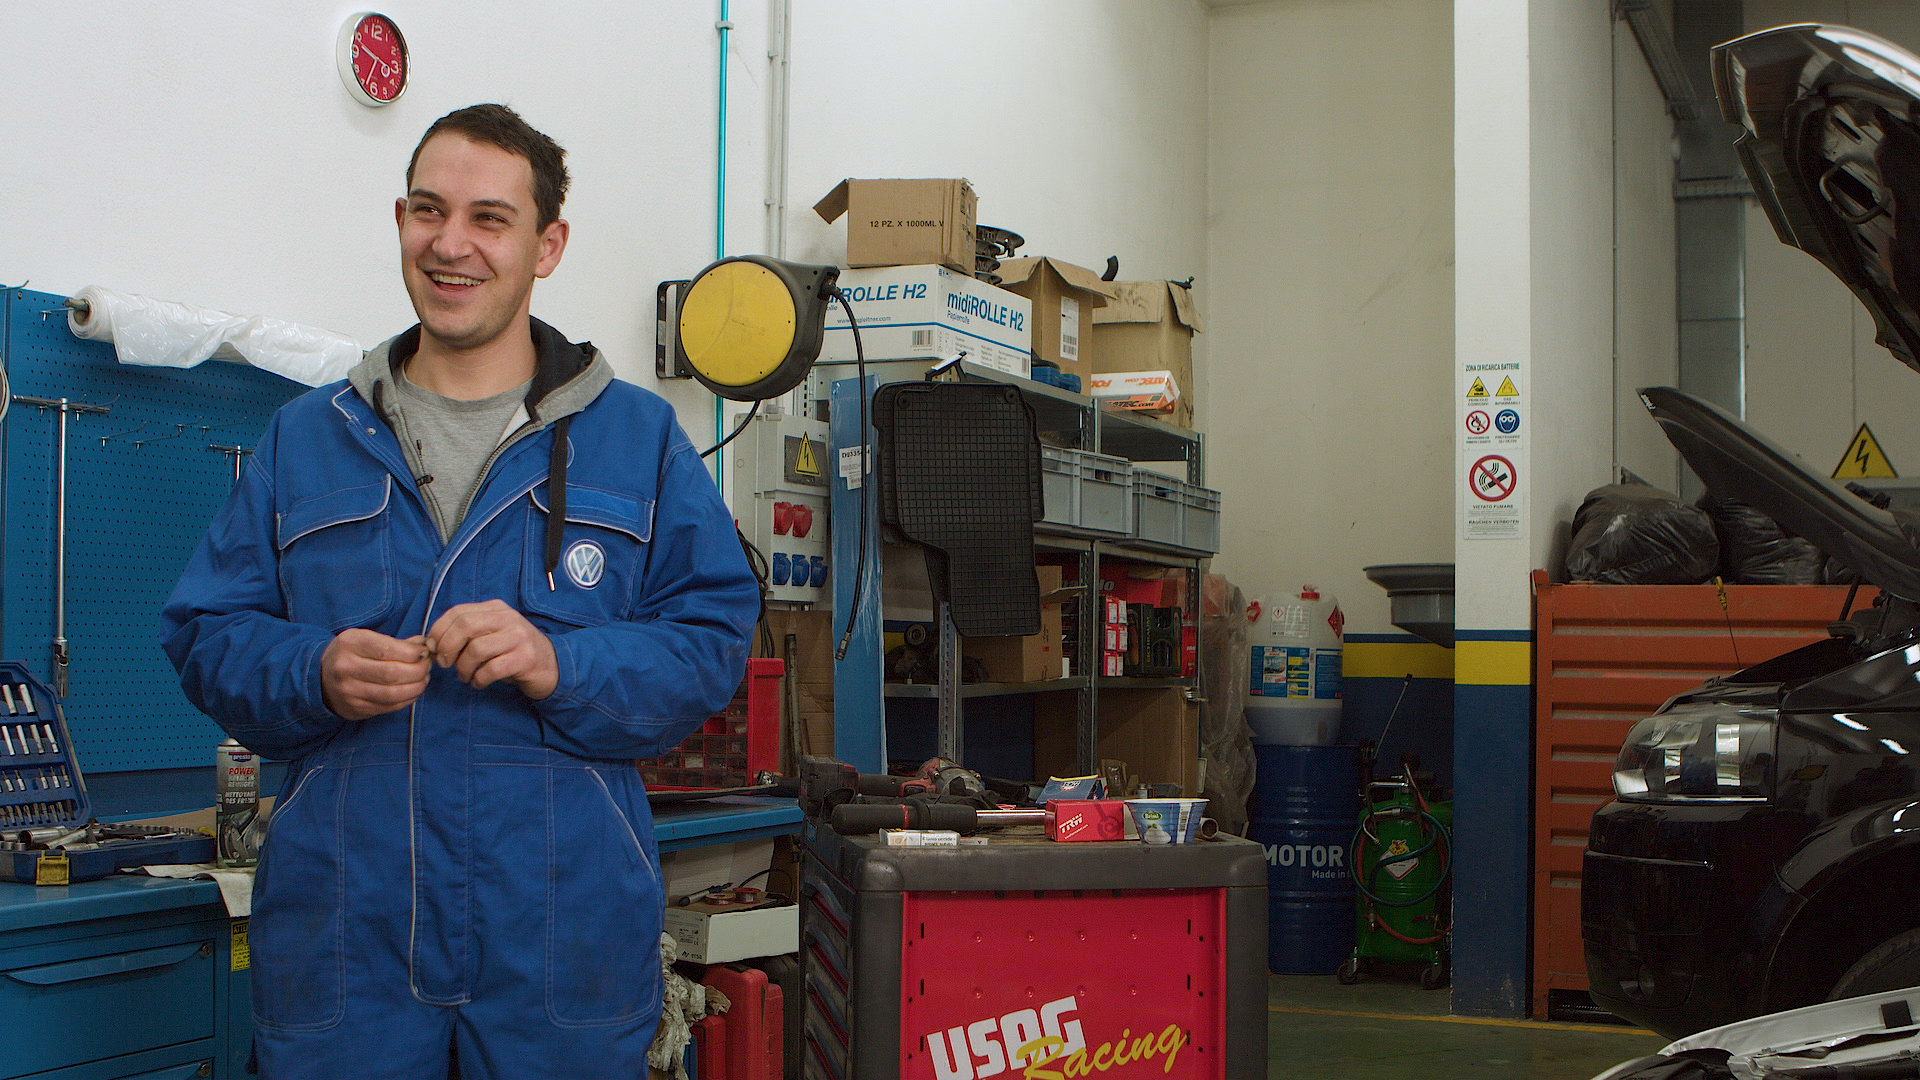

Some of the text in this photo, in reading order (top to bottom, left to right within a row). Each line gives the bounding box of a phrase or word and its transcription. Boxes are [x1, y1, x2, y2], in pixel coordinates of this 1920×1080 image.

[372, 23, 382, 41] 12
[352, 44, 360, 58] 9
[391, 46, 396, 56] 2
[391, 60, 399, 74] 3
[370, 82, 378, 96] 6
[903, 284, 927, 299] H2
[947, 292, 1024, 332] midiROLLE H2
[1501, 362, 1520, 370] BATTERIE
[229, 767, 255, 775] POWER
[1059, 813, 1083, 833] TRW
[1261, 844, 1344, 868] MOTOR
[1312, 870, 1336, 879] Made
[1337, 870, 1345, 879] in
[927, 996, 1087, 1080] USAG
[1016, 1023, 1188, 1080] Racing
